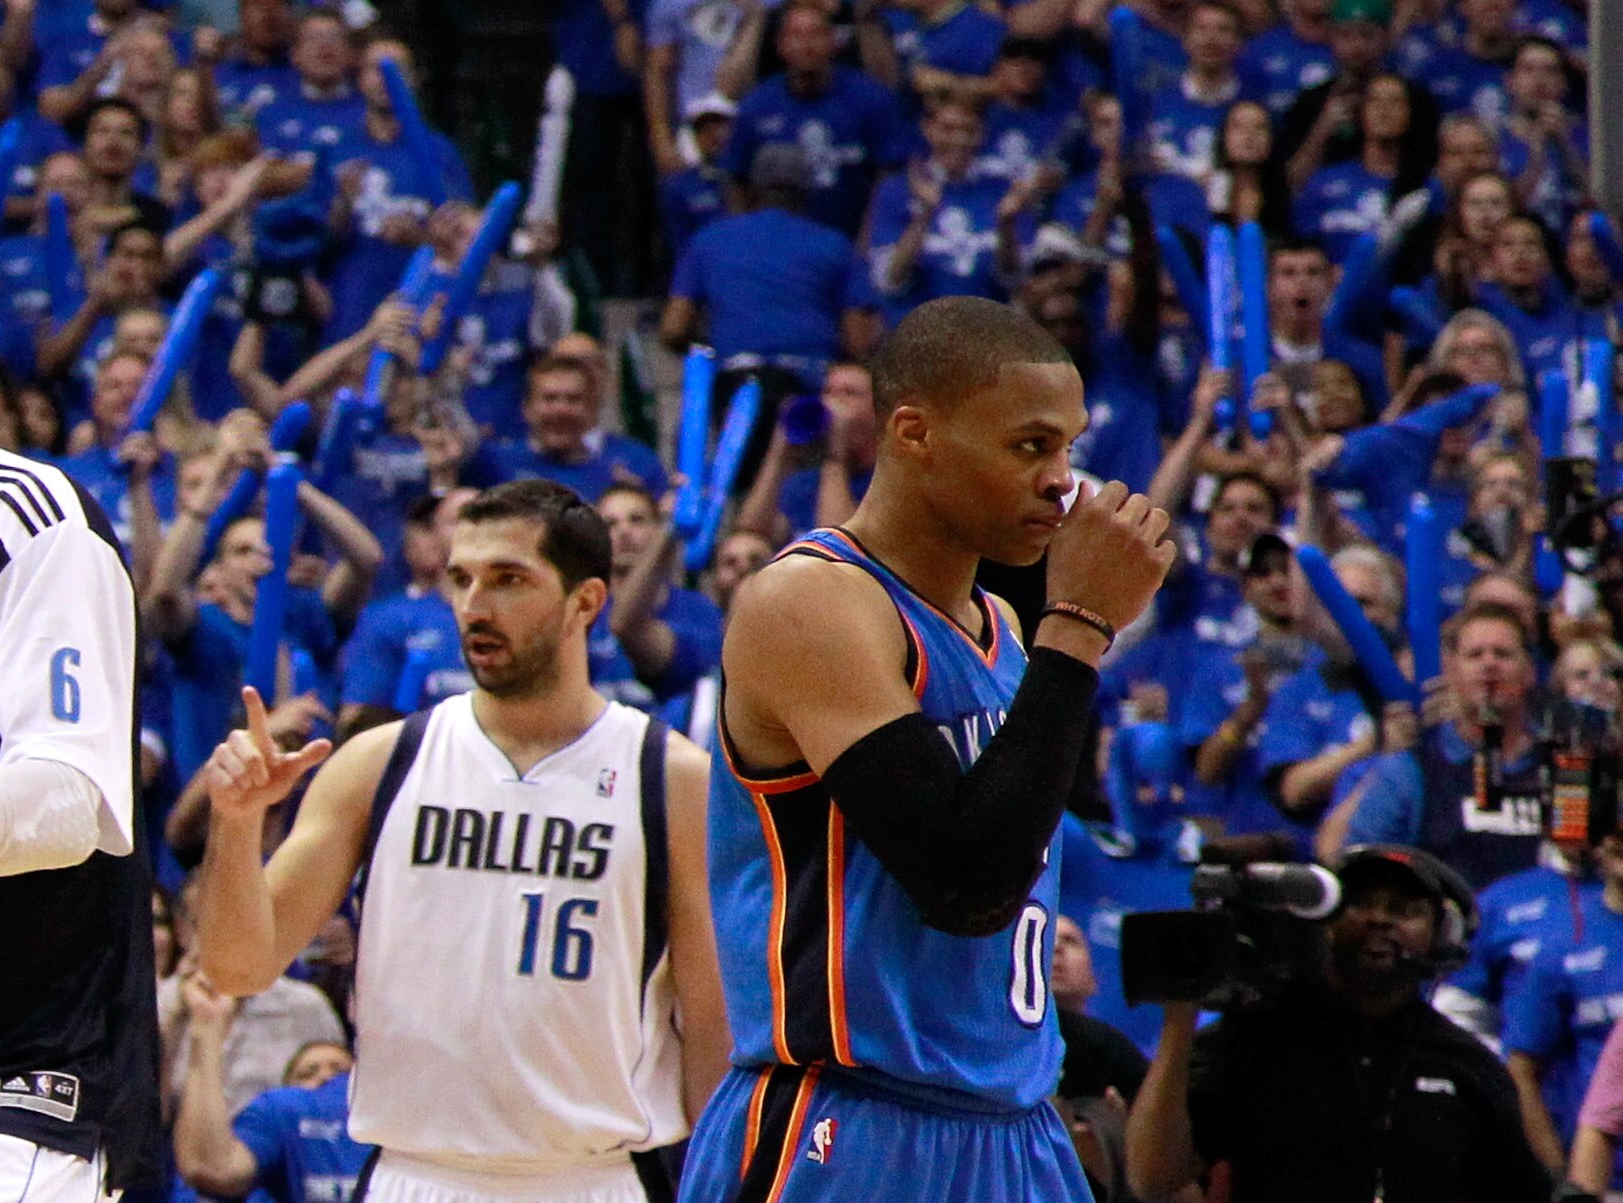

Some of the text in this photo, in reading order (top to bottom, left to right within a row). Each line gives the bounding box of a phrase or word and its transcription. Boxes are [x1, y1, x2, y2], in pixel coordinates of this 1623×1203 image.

[49, 646, 81, 724] 6
[410, 804, 616, 882] DALLAS
[516, 892, 600, 982] 16
[1010, 904, 1048, 1024] 0
